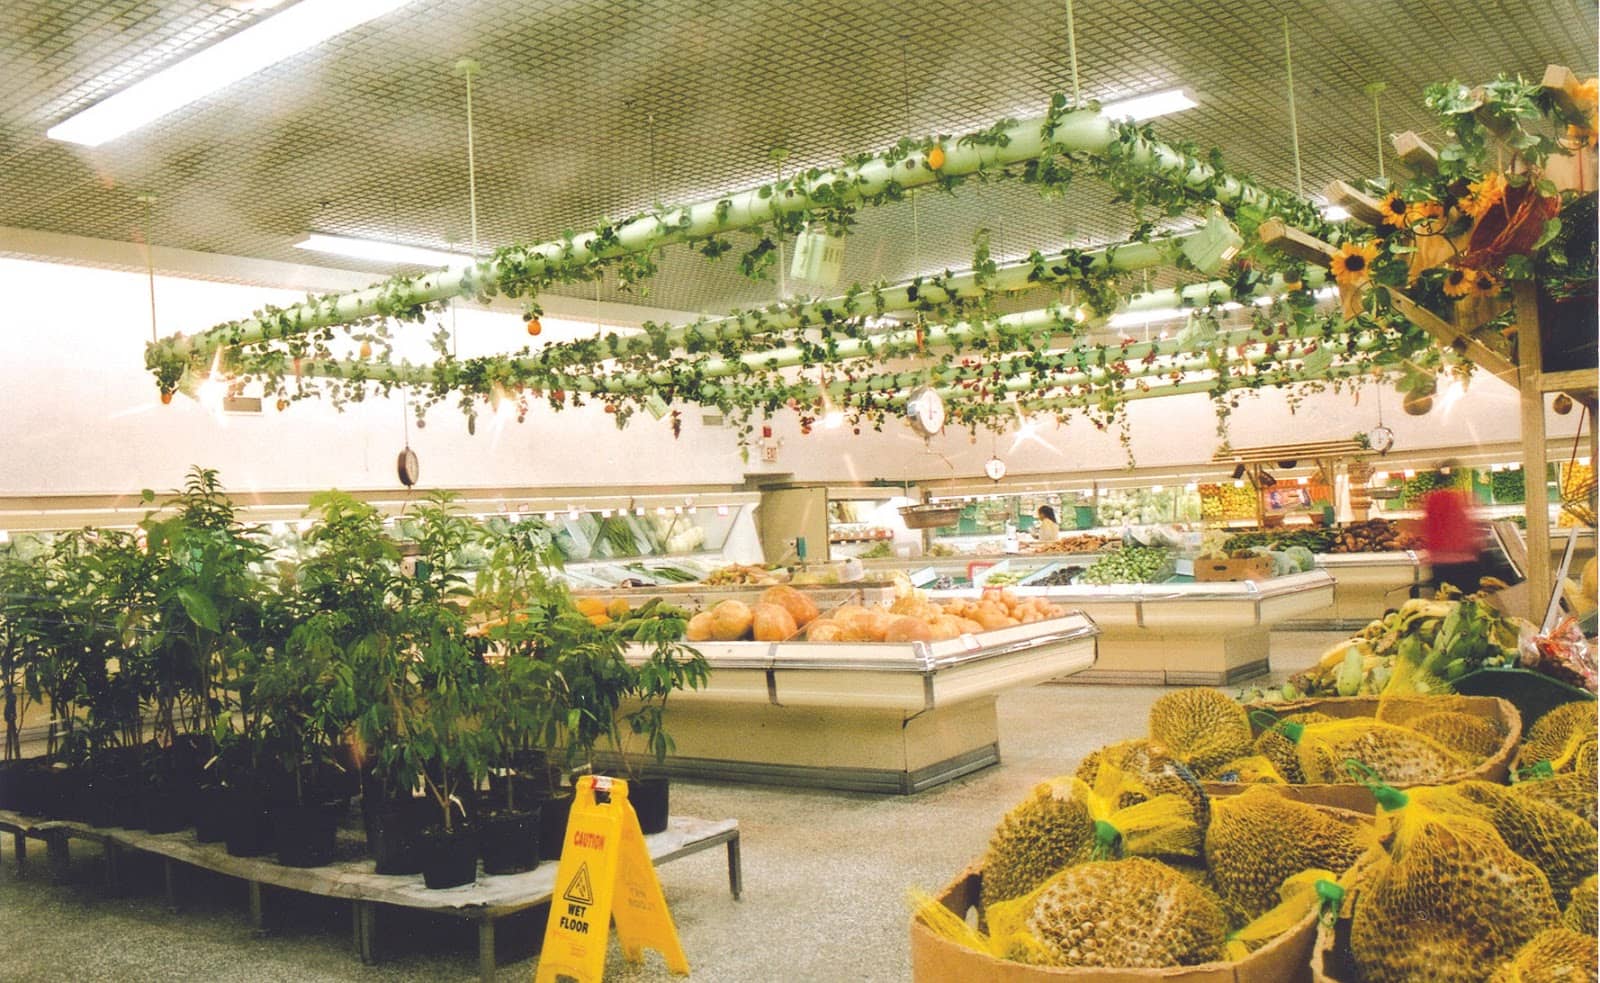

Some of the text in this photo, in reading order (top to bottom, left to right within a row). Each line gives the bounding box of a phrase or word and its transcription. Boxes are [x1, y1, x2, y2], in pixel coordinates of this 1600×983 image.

[766, 447, 777, 459] EXIT
[574, 831, 605, 850] CAUTION
[568, 904, 586, 918] WET
[560, 916, 589, 934] FLOOR
